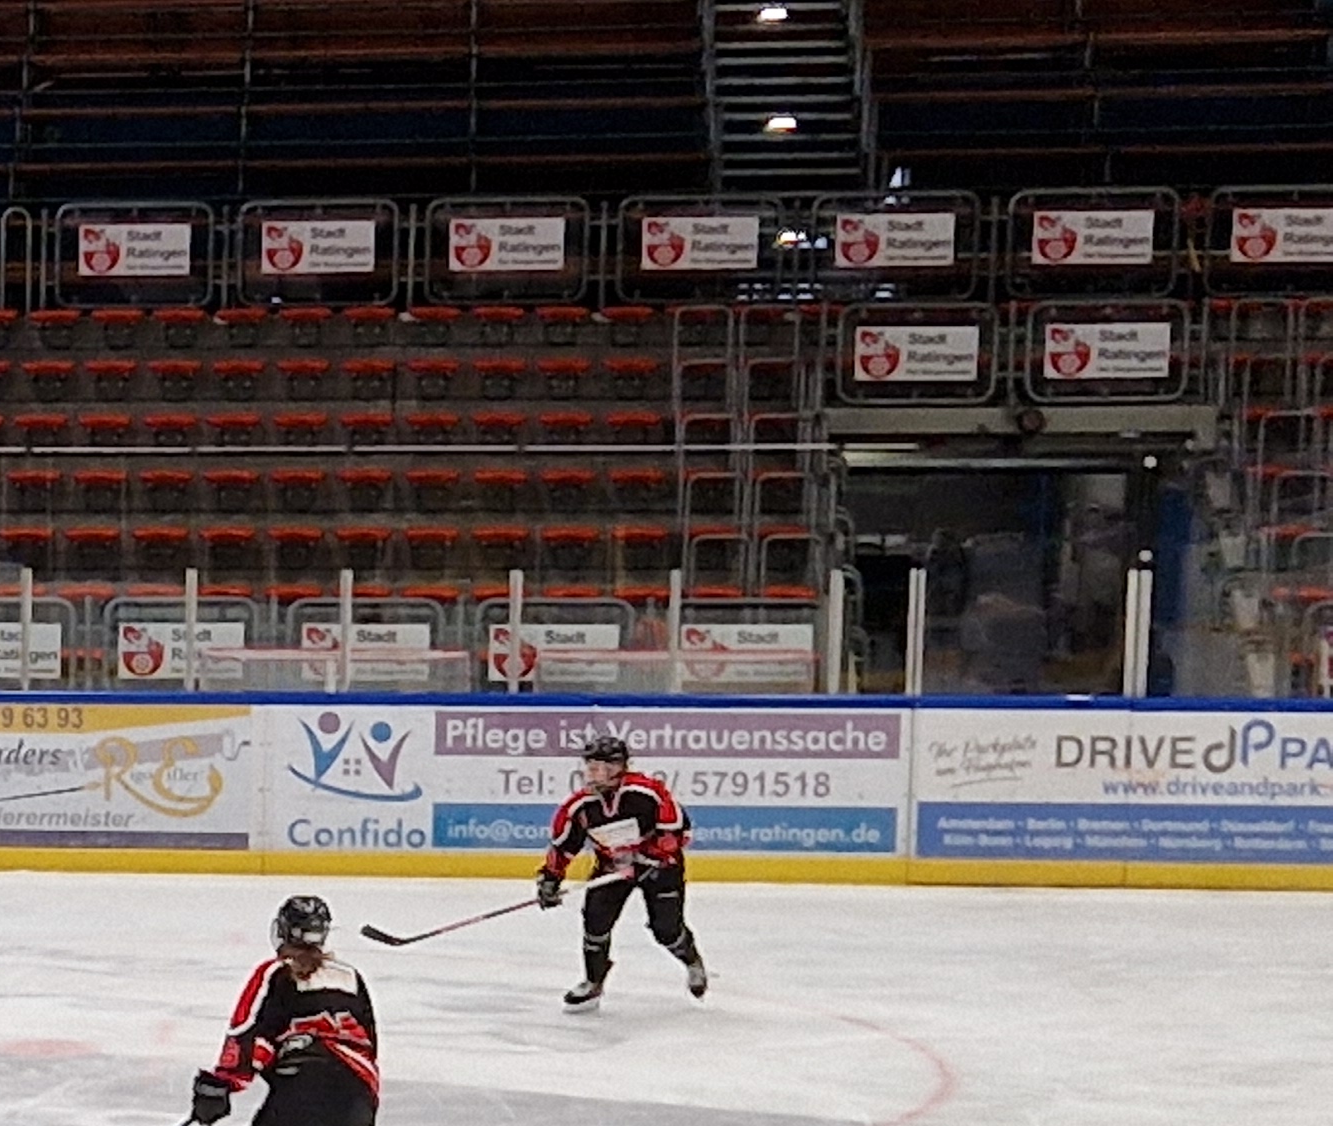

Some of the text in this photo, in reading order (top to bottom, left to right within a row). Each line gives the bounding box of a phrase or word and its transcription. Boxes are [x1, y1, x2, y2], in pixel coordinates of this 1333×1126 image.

[356, 629, 398, 644] Stadt
[545, 629, 587, 644] Stadt
[737, 629, 780, 644] Stadt
[21, 706, 49, 729] 63
[55, 706, 85, 729] 93
[445, 718, 888, 755] Pflege ist Vertrauenssache
[1054, 734, 1197, 770] DRIVE
[498, 768, 555, 795] Tel:
[690, 771, 831, 798] 5791518
[287, 818, 427, 849] Confido
